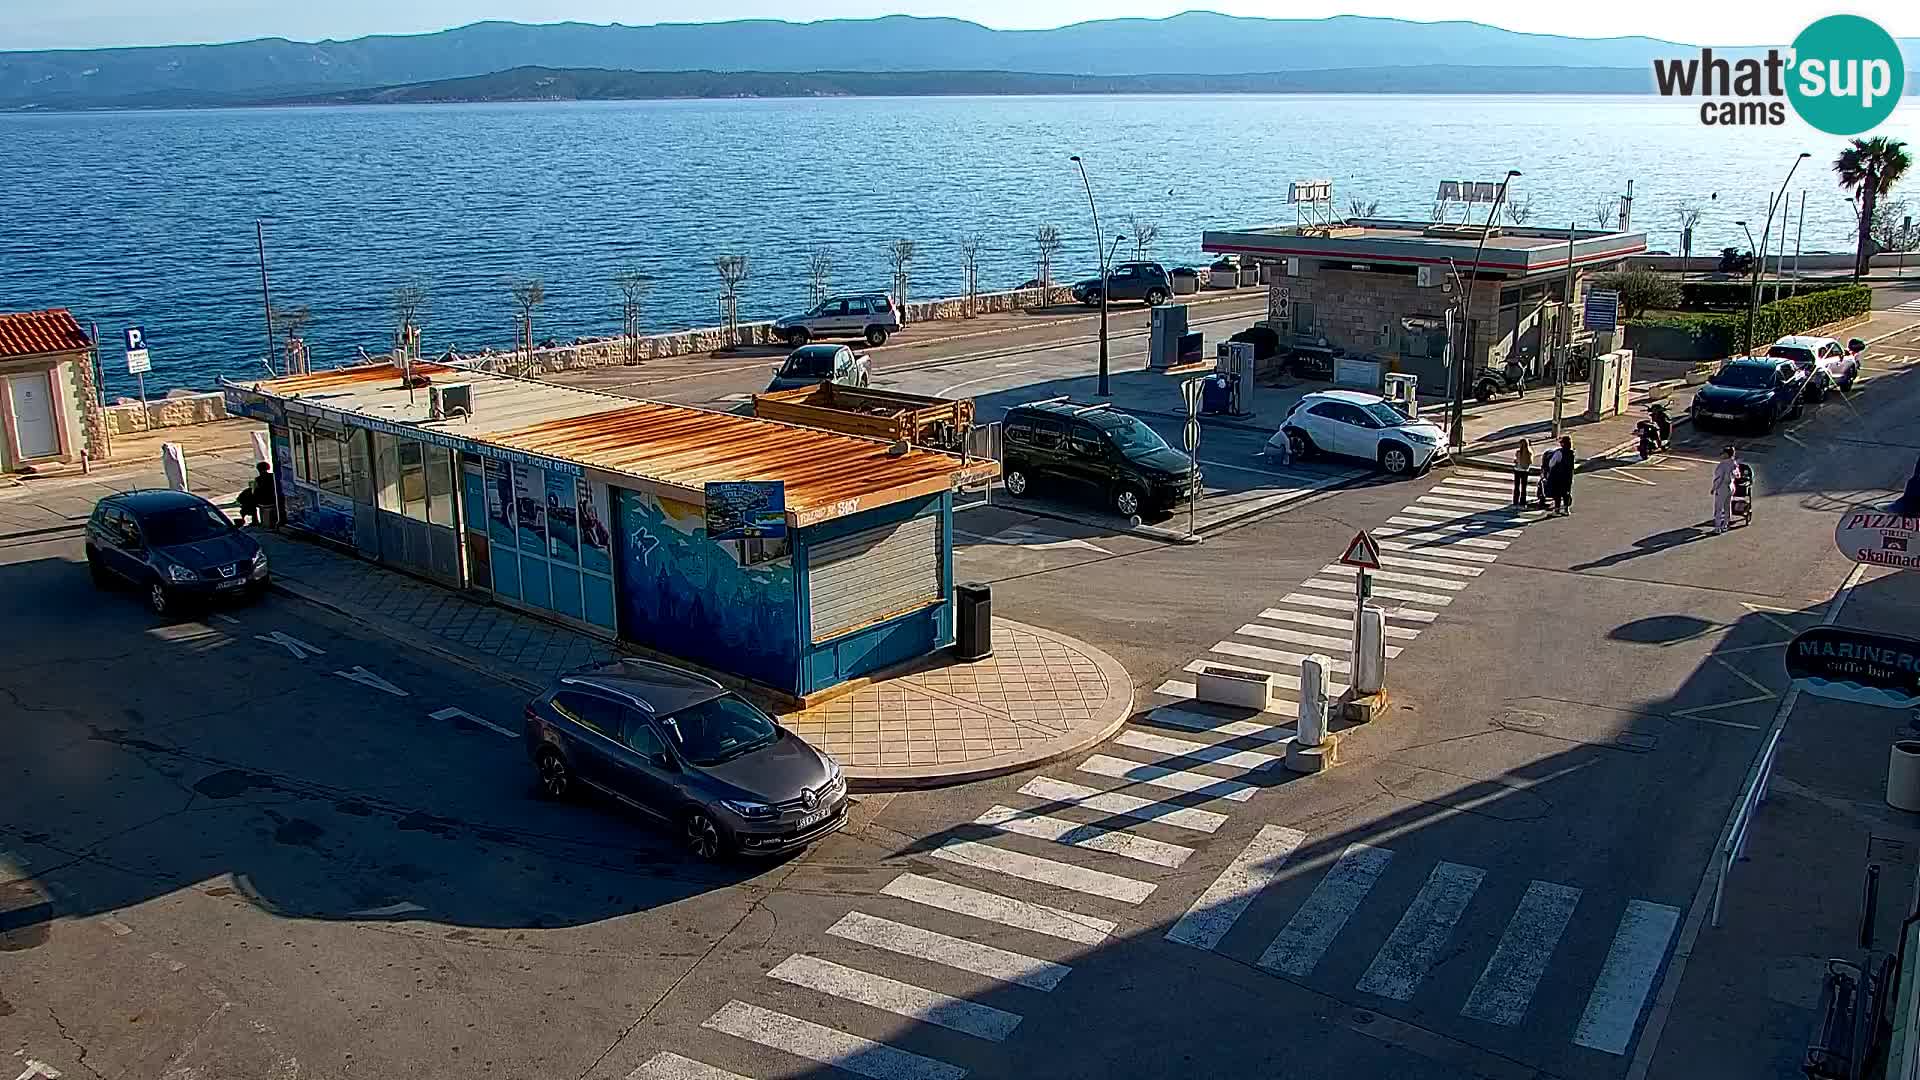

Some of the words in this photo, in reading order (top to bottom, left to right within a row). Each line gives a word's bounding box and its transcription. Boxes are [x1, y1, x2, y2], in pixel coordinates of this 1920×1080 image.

[128, 329, 142, 349] P
[476, 445, 492, 457] BUS
[493, 448, 525, 464] STATION
[527, 456, 553, 470] TICKET
[554, 462, 581, 476] OFFICE
[1845, 513, 1920, 532] PIZZE
